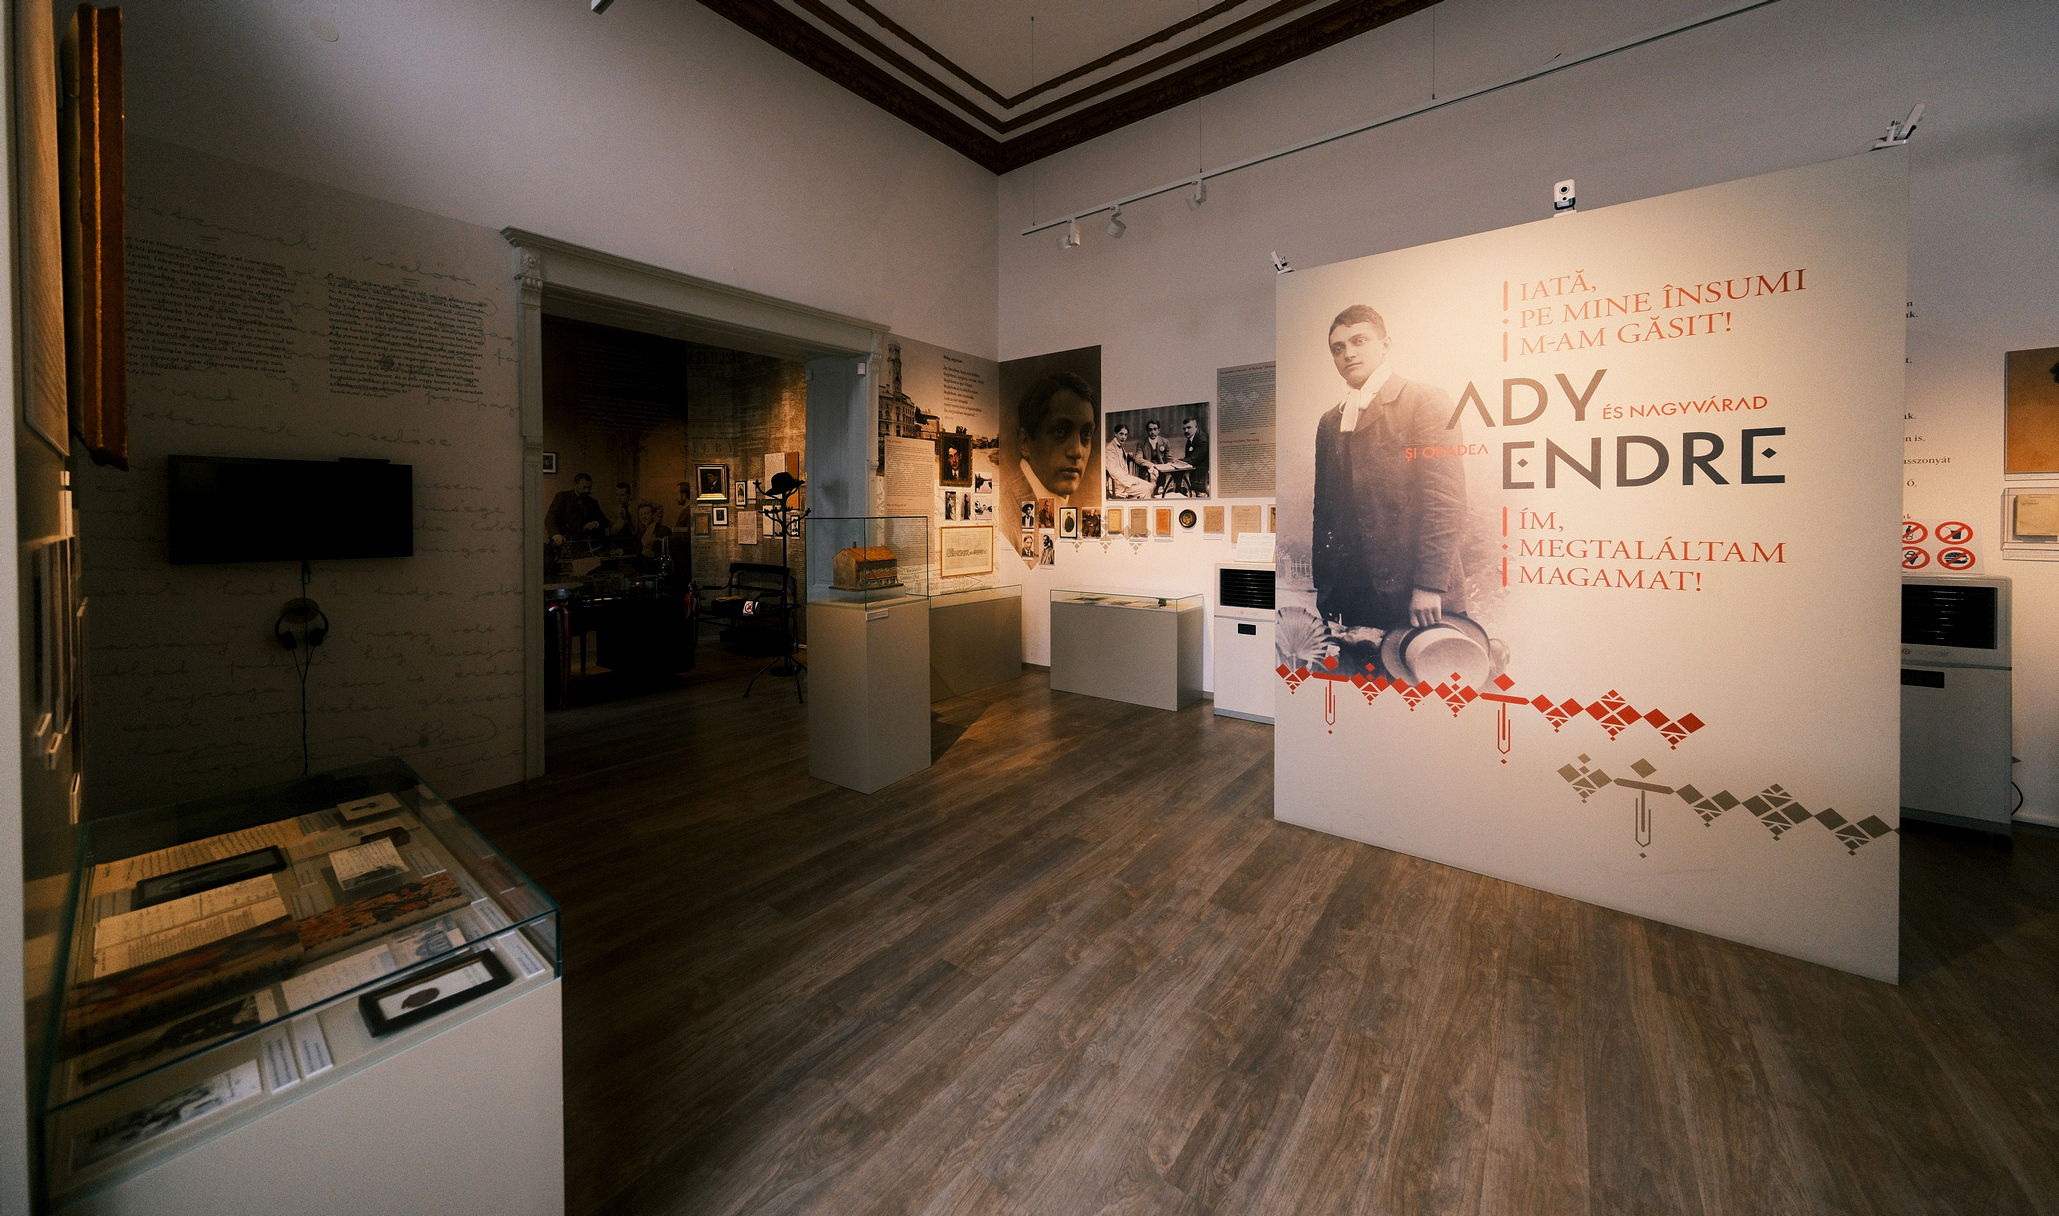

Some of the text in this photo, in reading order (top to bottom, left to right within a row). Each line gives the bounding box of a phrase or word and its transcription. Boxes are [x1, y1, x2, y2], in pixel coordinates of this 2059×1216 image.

[1519, 268, 1597, 301] IATĂ,
[1520, 268, 1807, 328] PE MINE ÎNSUMI
[1519, 311, 1732, 356] M-AM GĂSIT!
[1446, 369, 1608, 431] ADY
[1602, 395, 1768, 420] ÉS NAGYVÁRAD
[1502, 427, 1786, 491] ENDRE
[1519, 507, 1565, 532] ÍM,
[1519, 536, 1787, 564] MEGTALÁLTAM
[1519, 566, 1702, 592] MAGAMAT!
